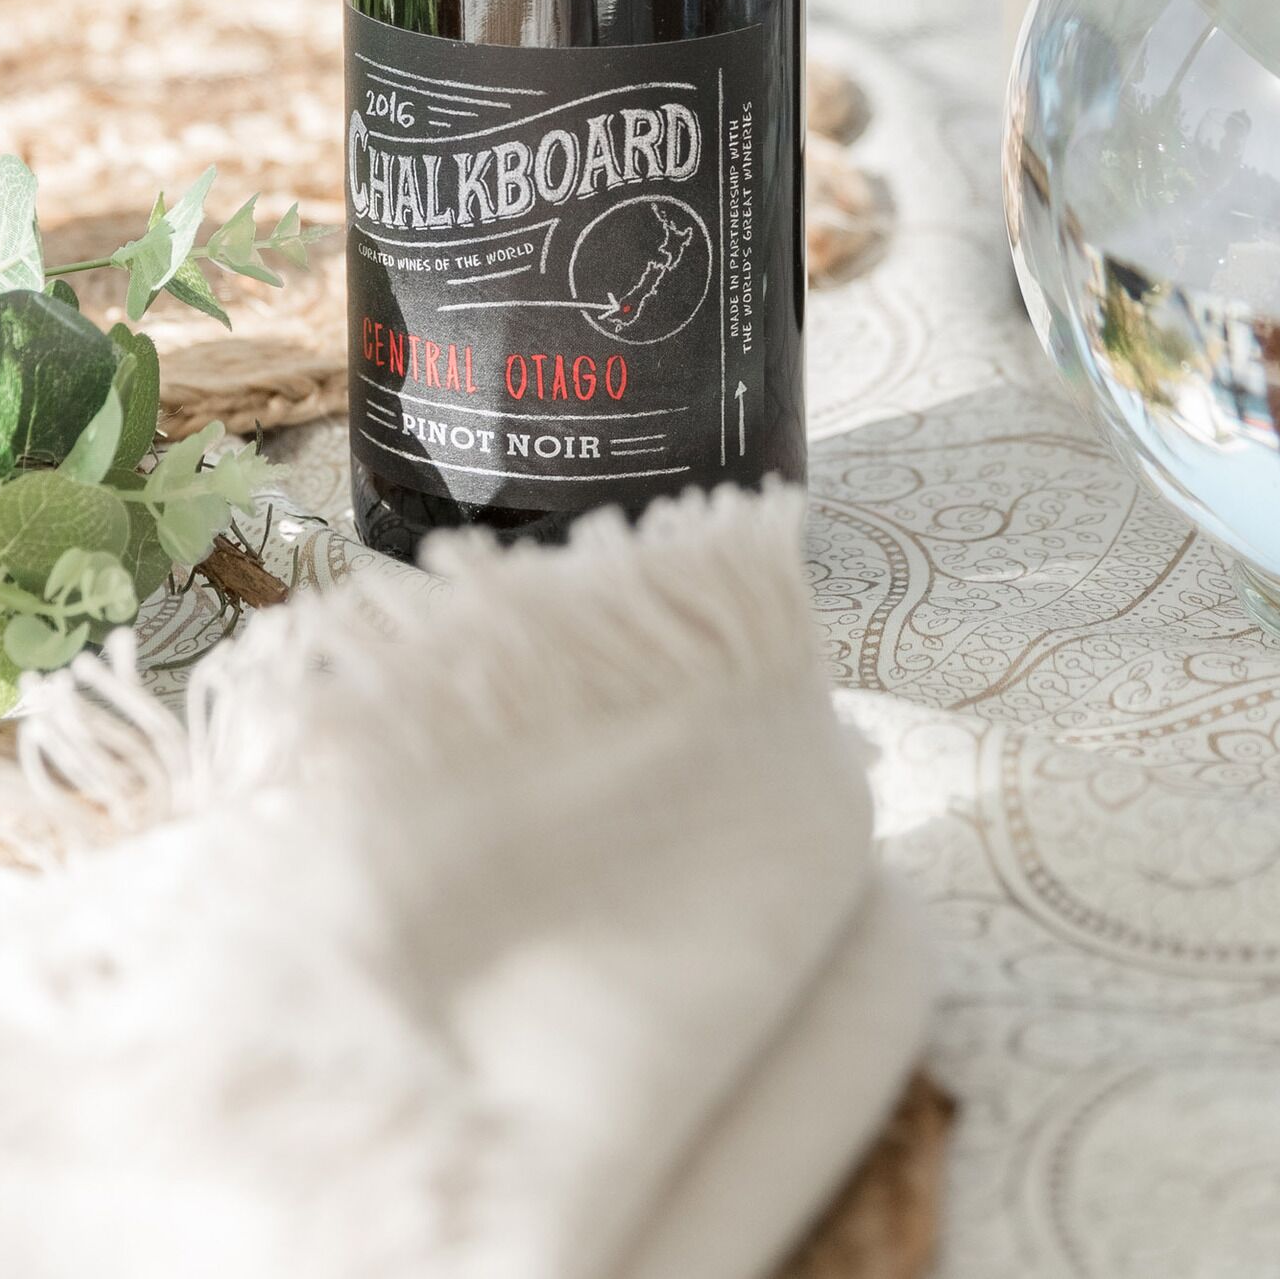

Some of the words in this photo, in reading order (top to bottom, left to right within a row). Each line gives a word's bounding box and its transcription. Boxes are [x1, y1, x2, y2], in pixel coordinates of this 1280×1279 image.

[365, 89, 416, 128] 2016
[728, 119, 740, 160] WITH
[742, 100, 753, 181] WINERIES
[348, 103, 702, 231] CHALKBOARD
[729, 164, 740, 270] PARTNERSHIP
[742, 186, 753, 241] GREAT
[357, 242, 395, 268] CURATED
[396, 256, 432, 272] WINES
[434, 257, 451, 271] OF
[454, 254, 482, 270] THE
[486, 242, 535, 266] WORLD
[742, 246, 753, 317] WORLD'S
[729, 274, 740, 291] IN
[729, 294, 740, 338] MADE
[742, 321, 752, 355] THE
[362, 316, 478, 394] CENTRAL
[505, 354, 628, 402] OTAGO
[401, 411, 495, 454] PINOT
[506, 432, 602, 460] NOIR
